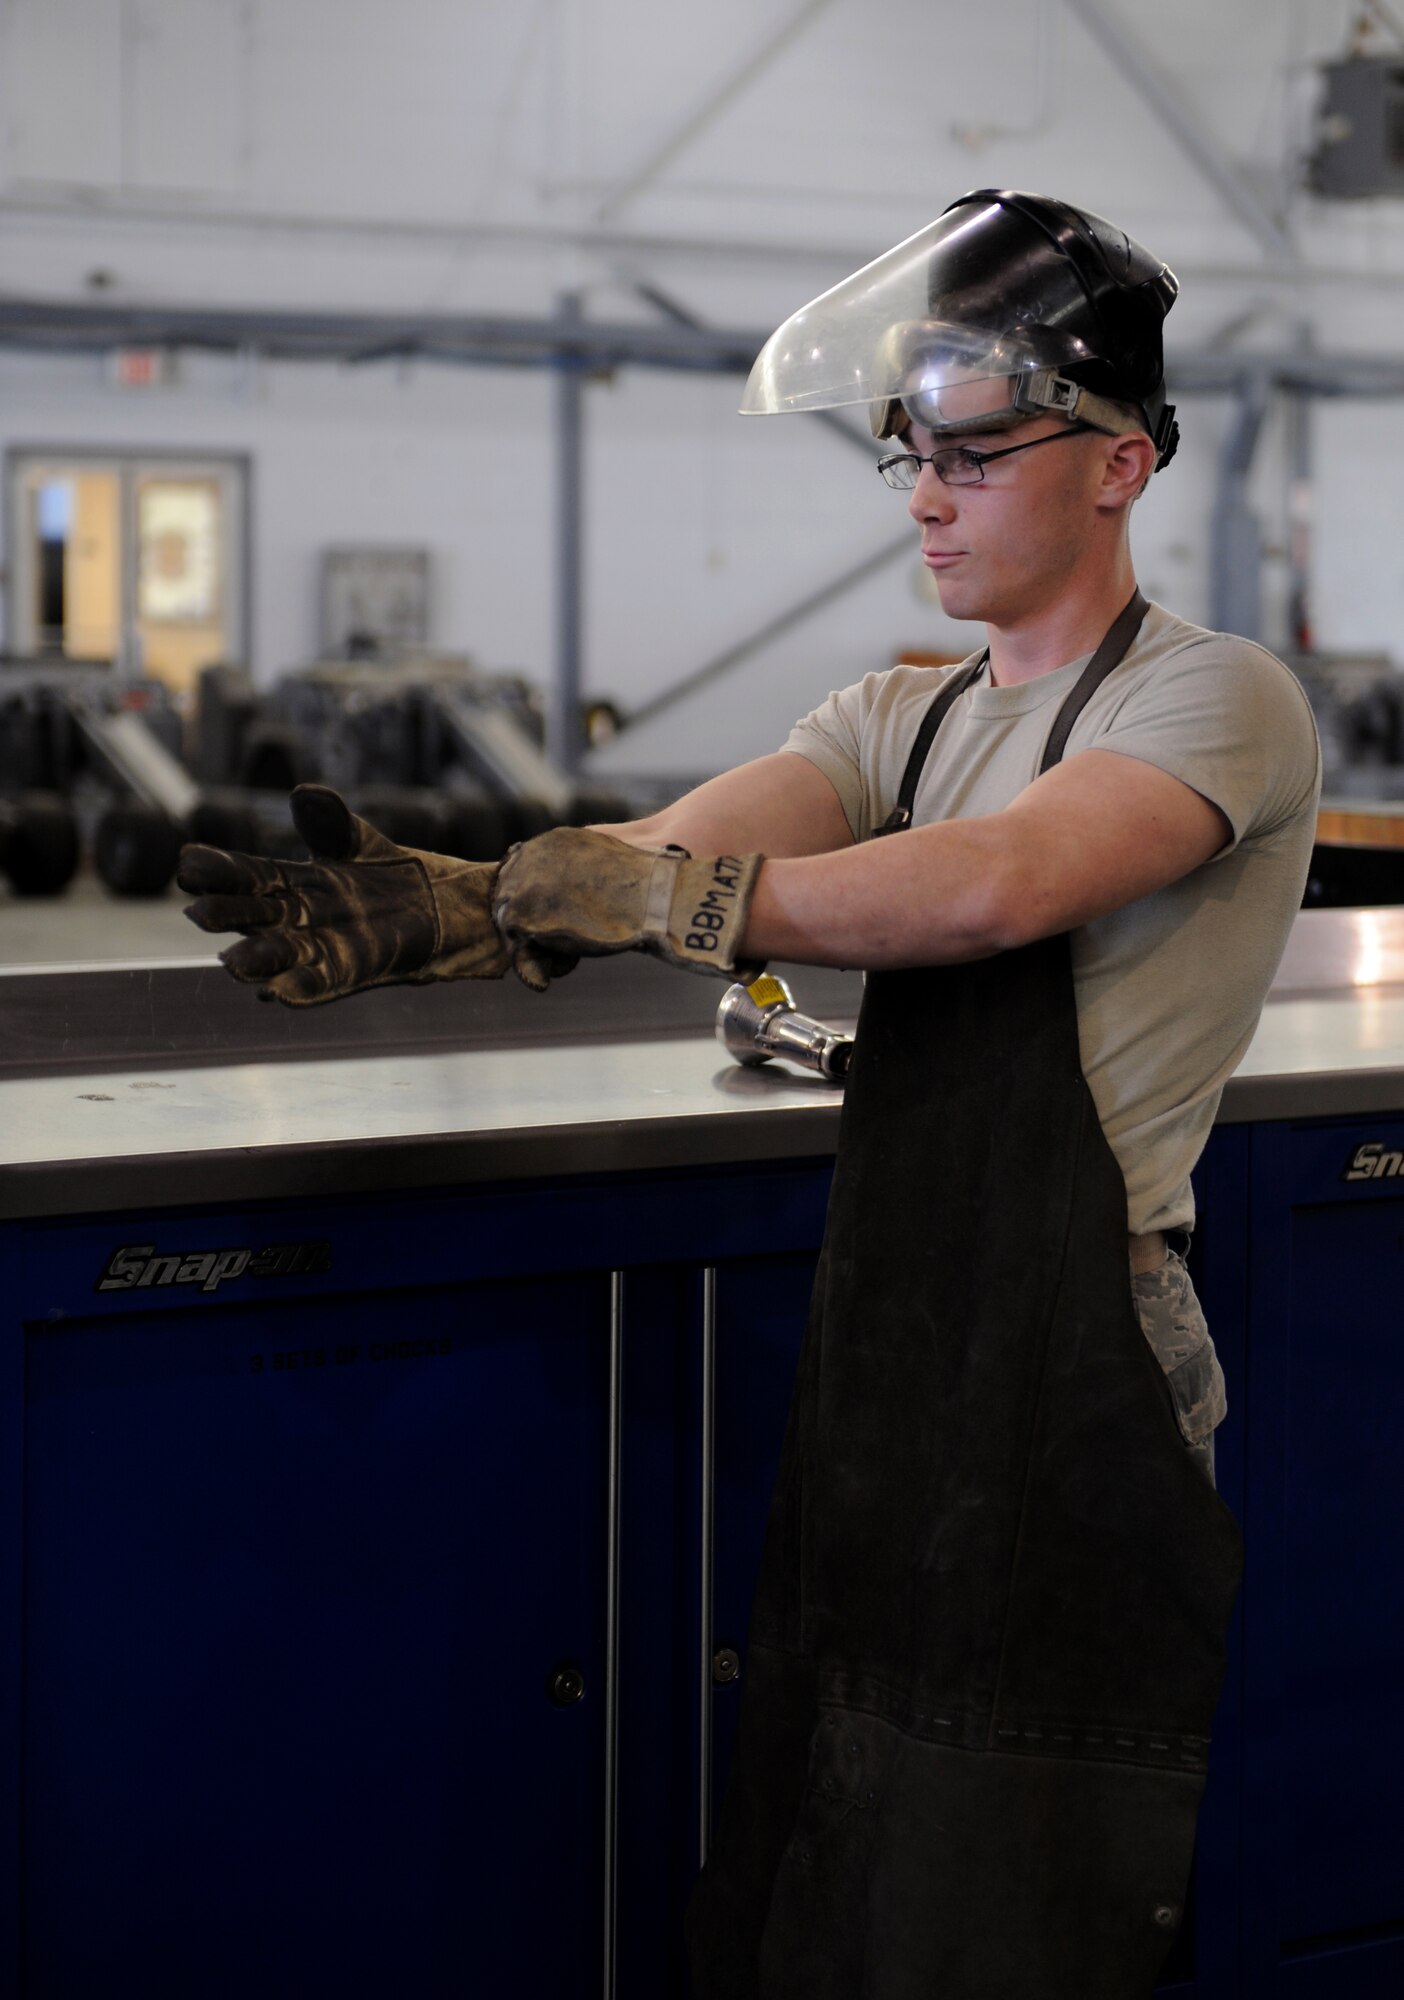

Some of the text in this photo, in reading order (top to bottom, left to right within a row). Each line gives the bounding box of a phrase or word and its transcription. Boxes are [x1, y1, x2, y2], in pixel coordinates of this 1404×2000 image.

[249, 1335, 453, 1373] 3 SETS OF CHOCKS
